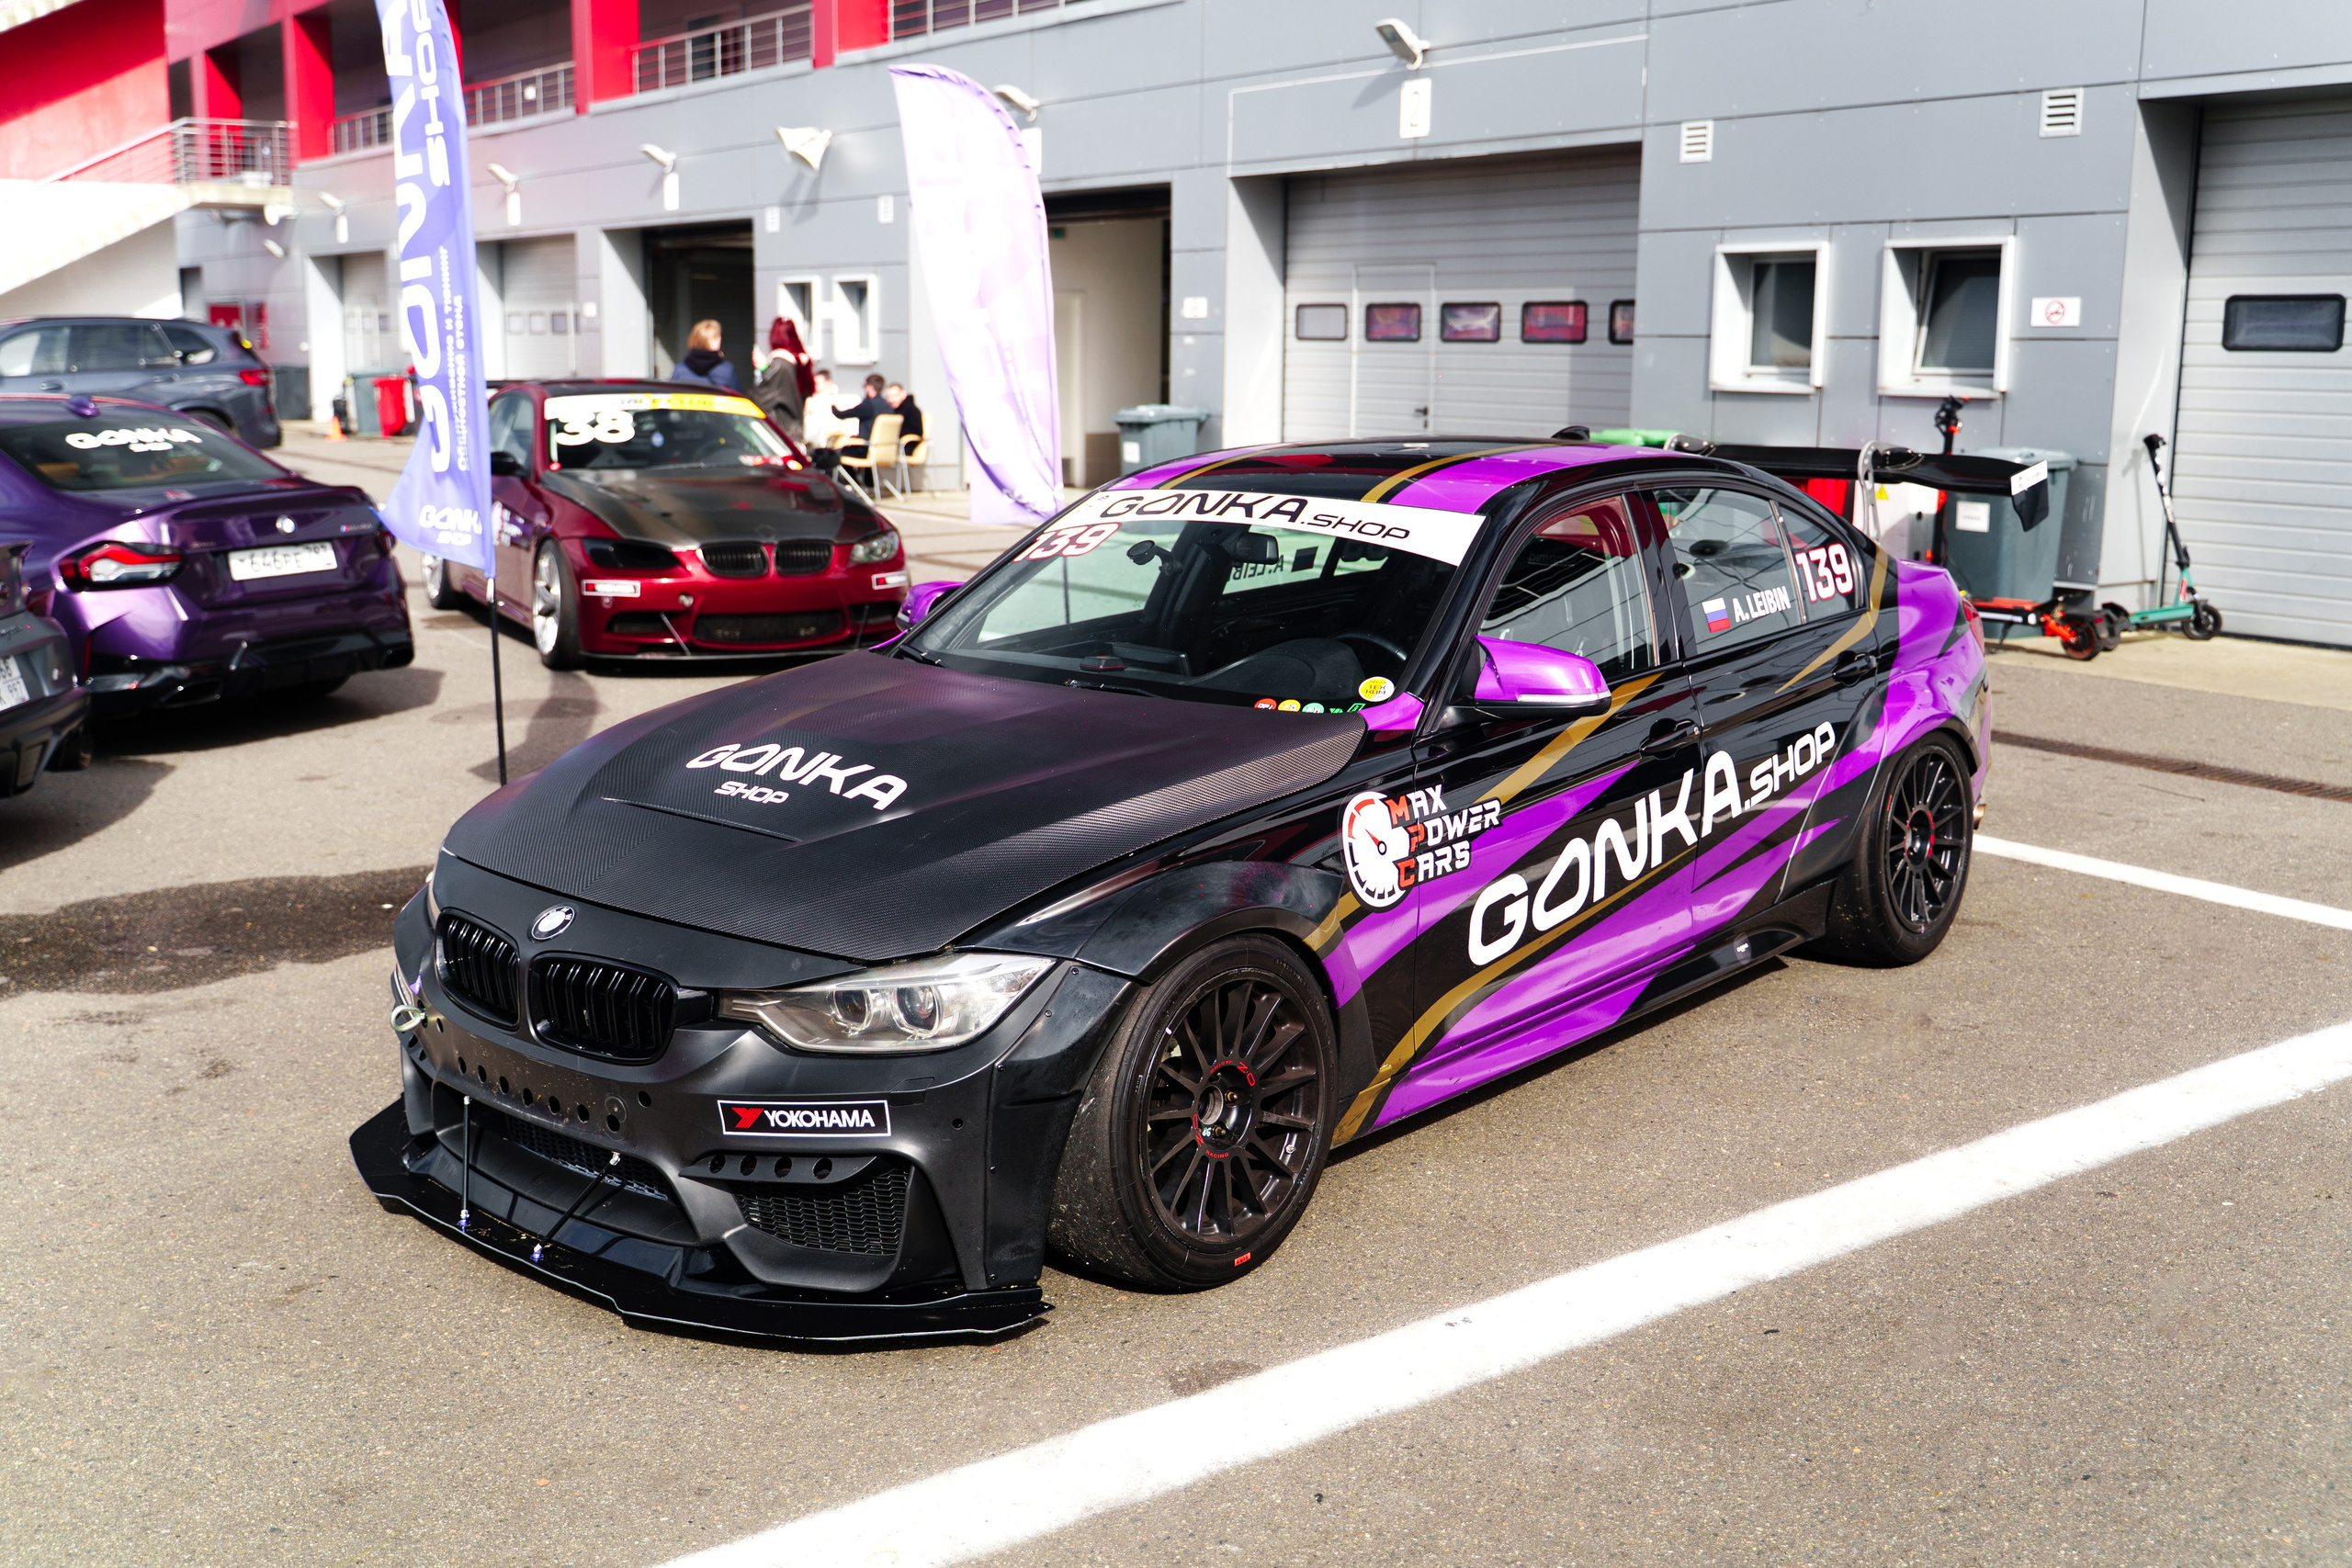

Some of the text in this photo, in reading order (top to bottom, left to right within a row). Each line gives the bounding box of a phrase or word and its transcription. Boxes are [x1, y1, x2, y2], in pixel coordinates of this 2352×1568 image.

[555, 409, 636, 446] 38
[1012, 522, 1123, 563] 139
[1795, 543, 1854, 603] 139
[685, 743, 908, 810] GONKA
[714, 781, 789, 804] SHOP
[1385, 784, 1448, 826] MAX
[1407, 799, 1501, 852] POWER
[1396, 840, 1470, 888] CARS
[763, 1110, 876, 1128] YOKOHAMA
[1205, 1149, 1229, 1158] RACING
